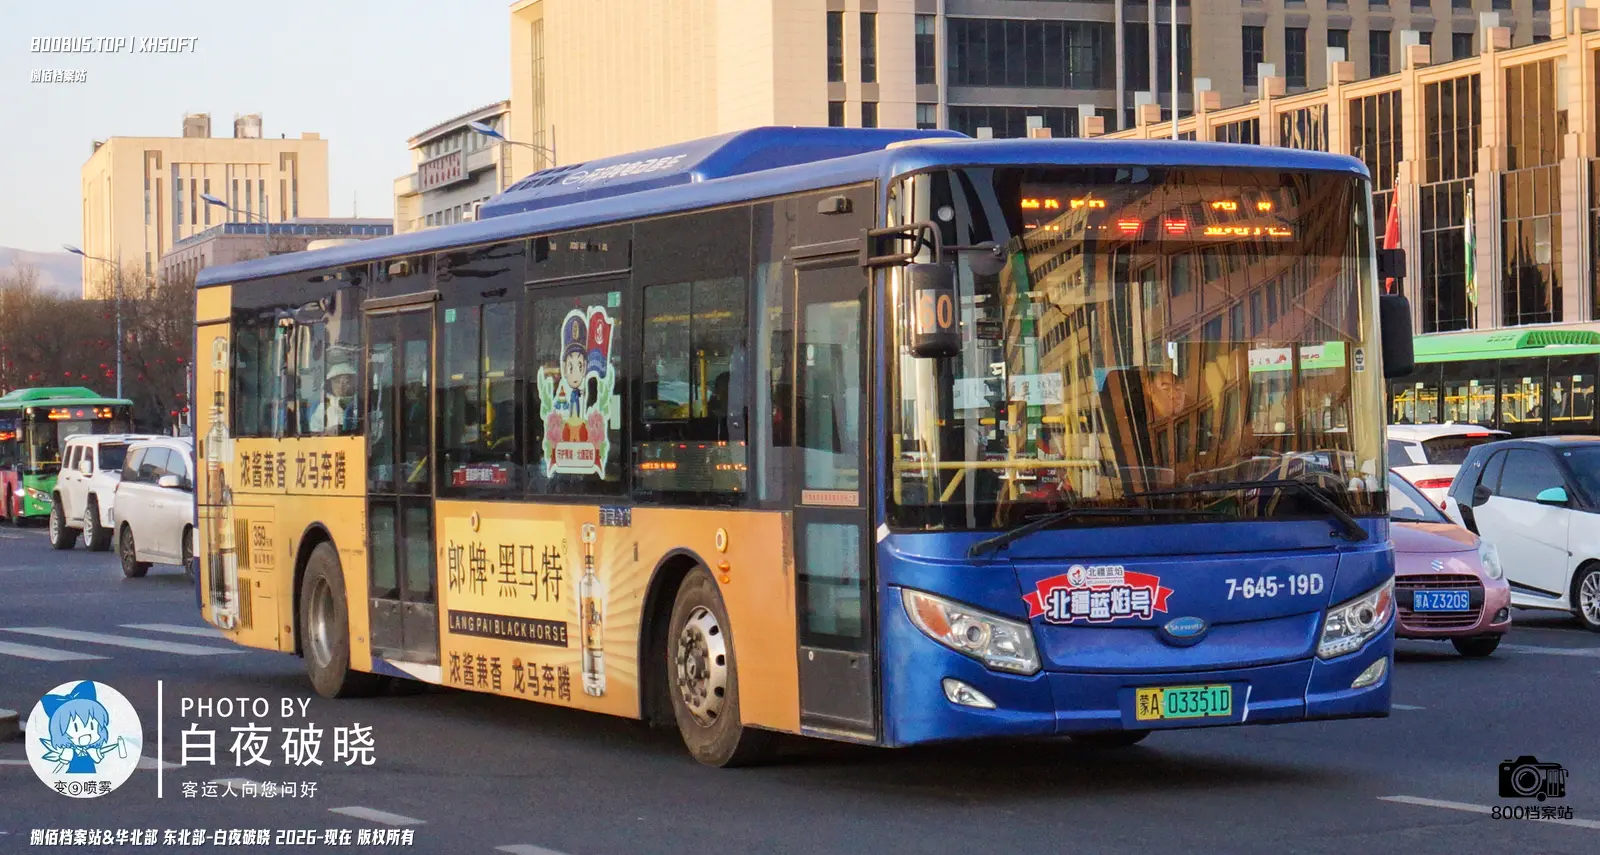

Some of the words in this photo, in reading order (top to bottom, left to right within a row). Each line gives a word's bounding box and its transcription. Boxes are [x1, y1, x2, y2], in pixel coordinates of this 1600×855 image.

[920, 294, 953, 329] 60
[240, 451, 286, 488] 浓酱兼香
[295, 450, 346, 489] 龙马奔腾
[1088, 567, 1124, 577] 北疆蓝焰
[1225, 573, 1324, 600] 7-645-19D
[1047, 588, 1151, 620] 北疆蓝焰号
[449, 651, 503, 691] 浓酱兼香
[512, 661, 571, 701] 龙马奔腾
